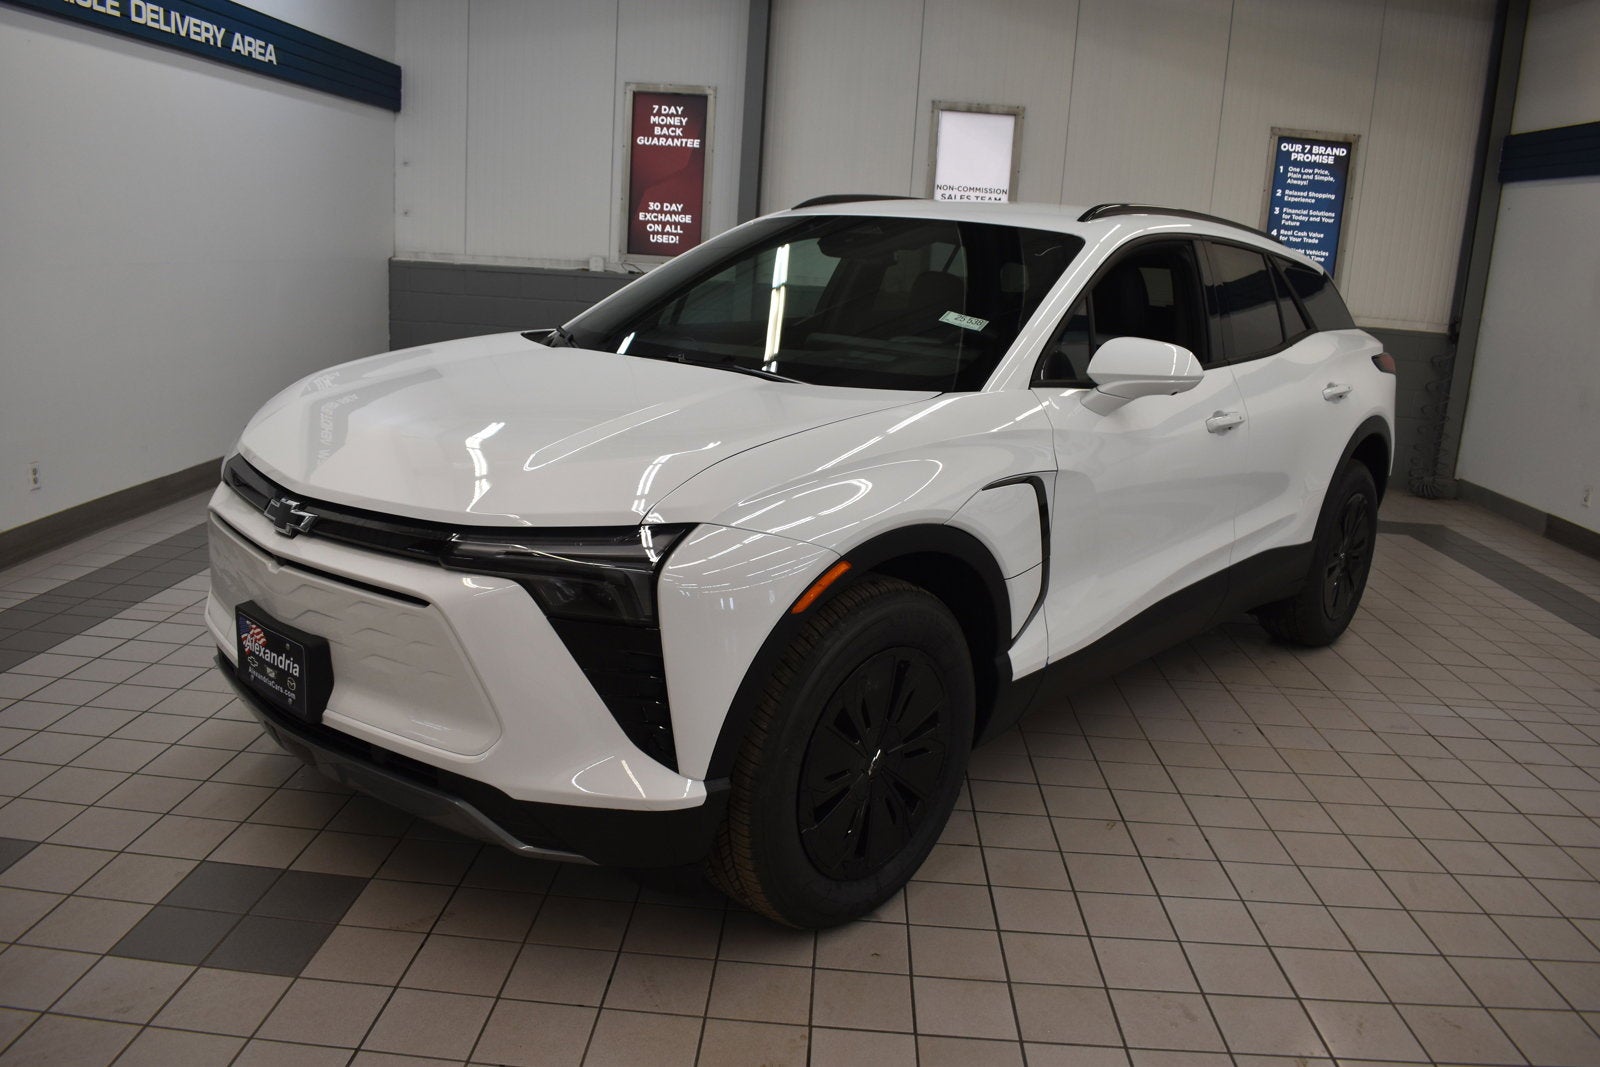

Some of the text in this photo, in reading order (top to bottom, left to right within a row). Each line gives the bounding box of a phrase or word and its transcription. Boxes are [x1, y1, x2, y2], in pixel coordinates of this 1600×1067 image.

[130, 0, 226, 48] DELIVERY
[231, 32, 278, 65] AREA
[652, 105, 684, 114] 7 DAY
[650, 116, 688, 126] MONEY
[654, 126, 683, 136] BACK
[636, 136, 700, 148] GUARANTEE
[1280, 143, 1302, 152] OUR
[1312, 146, 1347, 156] BRAND
[1291, 152, 1334, 164] PROMISE
[936, 184, 1008, 195] NON-COMMISSION
[1309, 191, 1335, 200] Shopping
[648, 202, 683, 212] 30 DAY
[638, 212, 692, 223] EXCHANGE
[646, 224, 684, 233] ON ALL
[650, 234, 679, 244] USED!
[243, 636, 299, 677] Alexandria
